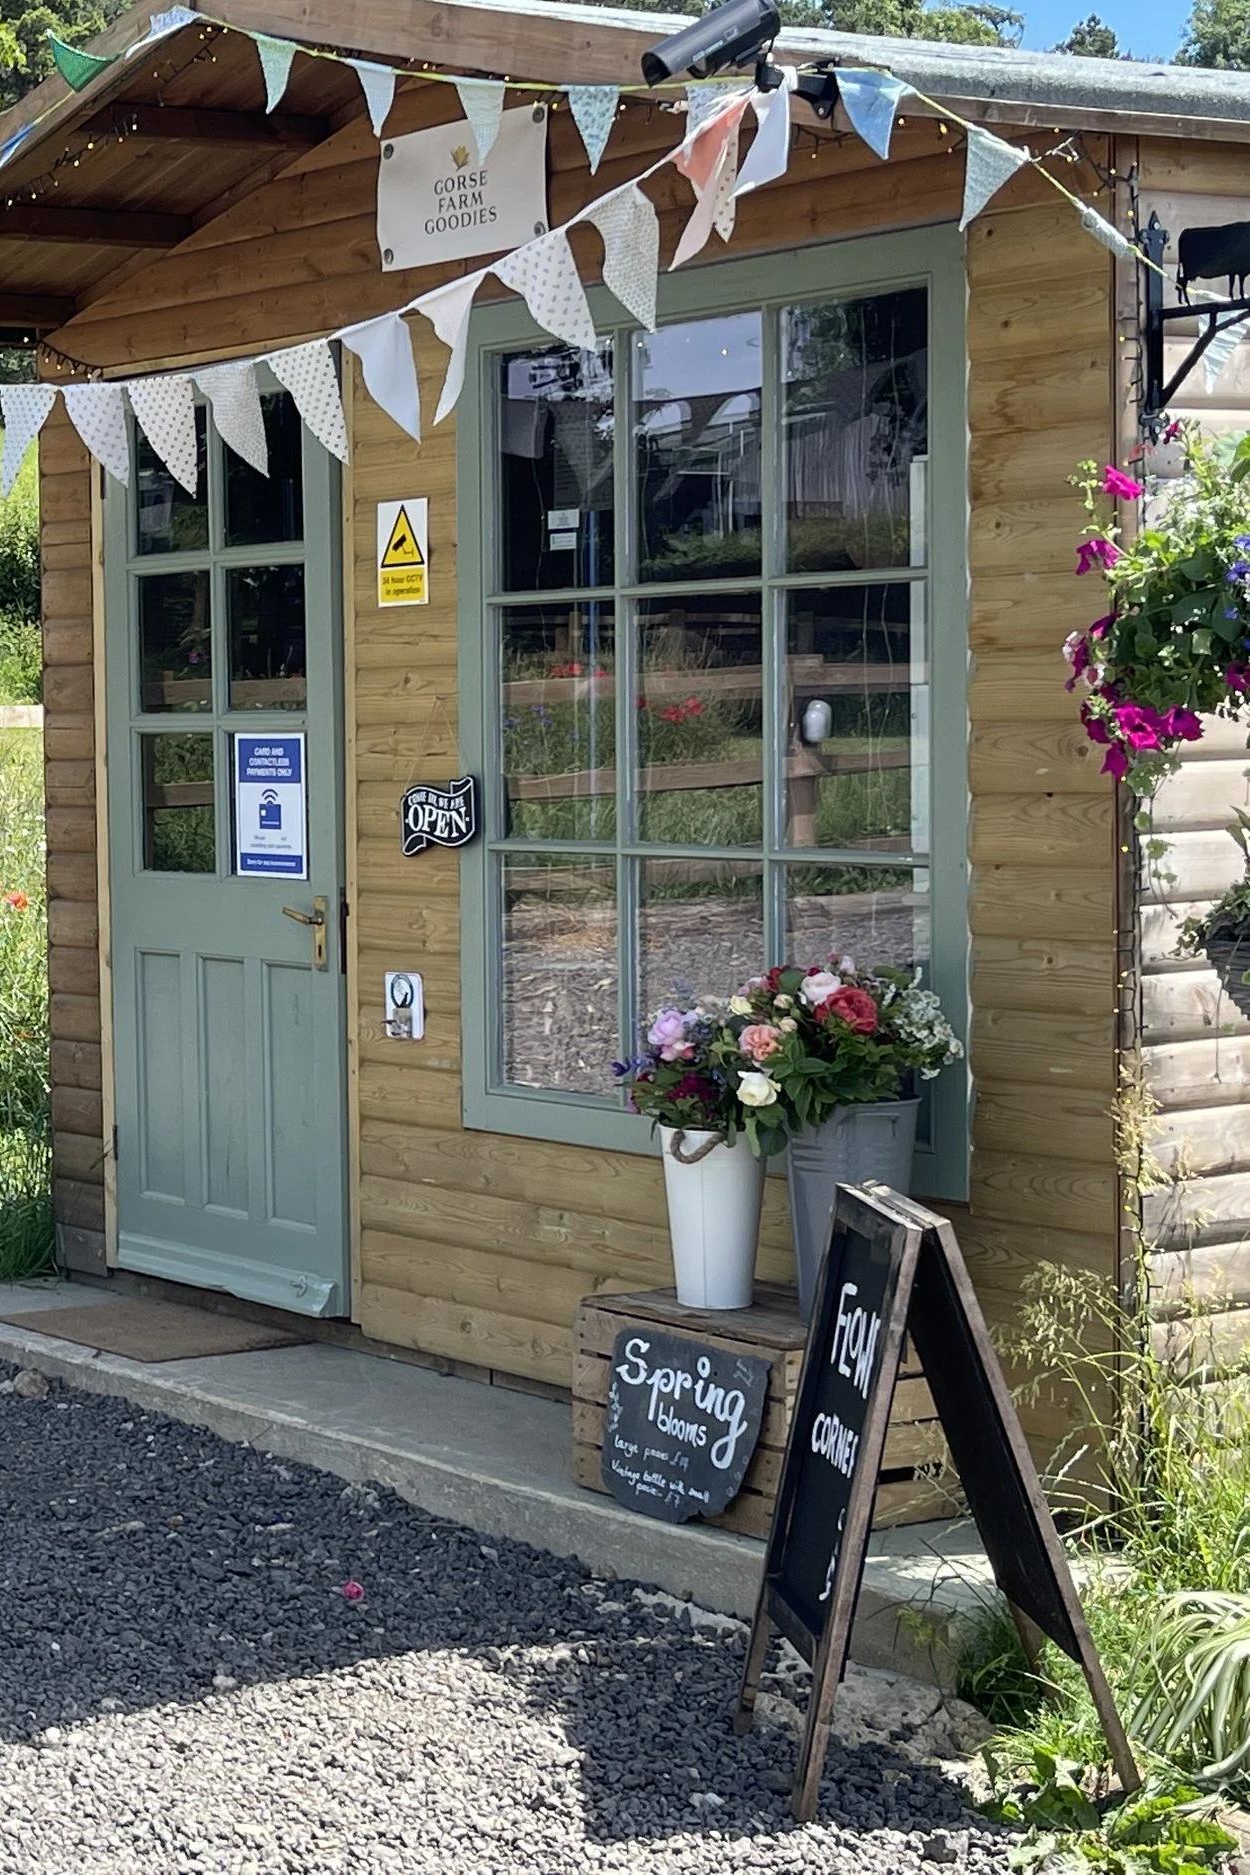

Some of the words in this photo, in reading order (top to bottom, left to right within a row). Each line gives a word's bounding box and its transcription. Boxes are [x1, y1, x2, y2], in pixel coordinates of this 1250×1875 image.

[433, 170, 488, 196] GORSE
[437, 190, 484, 214] FARM
[424, 206, 498, 235] GOODIES
[254, 747, 270, 756] CARD
[271, 747, 284, 756] AND
[408, 804, 467, 838] OPEN
[830, 1282, 881, 1399] FLOW
[615, 1338, 748, 1470] Spring
[656, 1401, 708, 1448] blooms
[811, 1412, 859, 1479] CORNE
